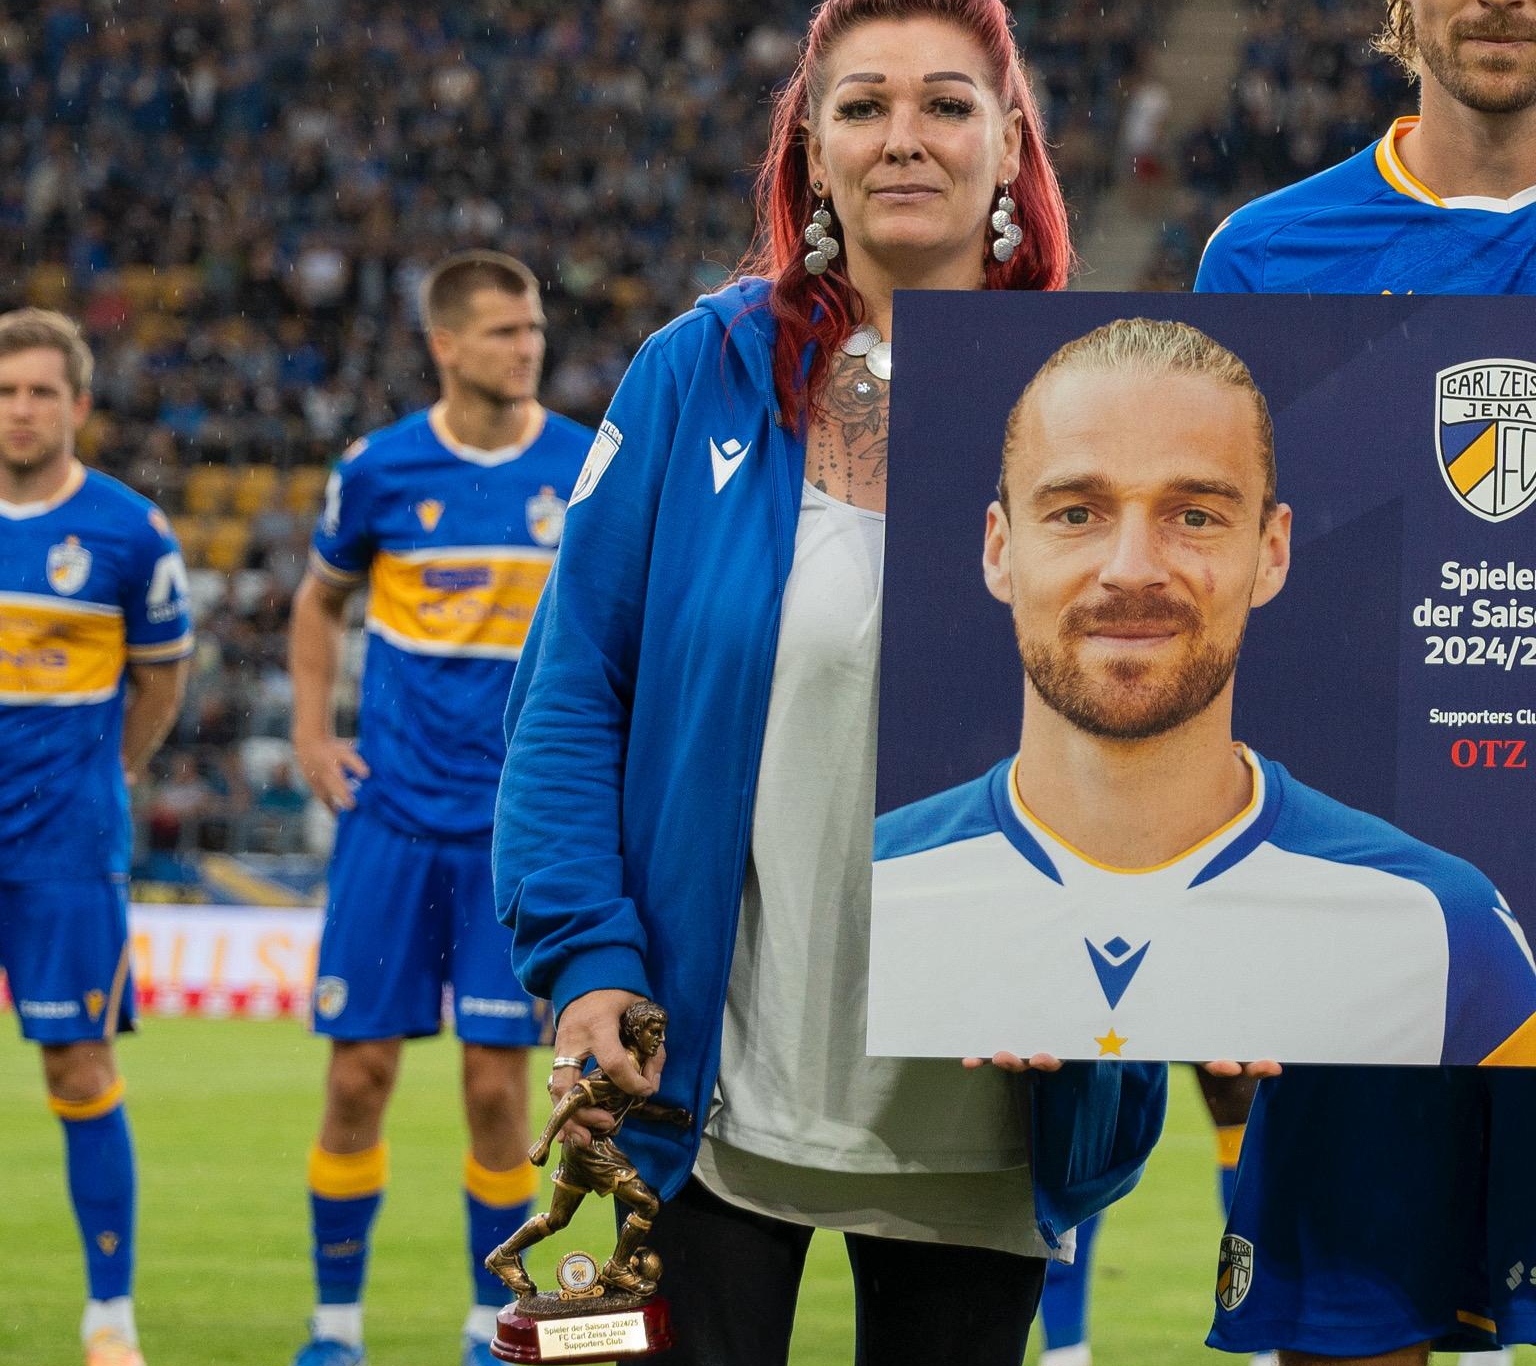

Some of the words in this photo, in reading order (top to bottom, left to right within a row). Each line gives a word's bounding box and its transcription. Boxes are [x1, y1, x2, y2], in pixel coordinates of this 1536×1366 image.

[1446, 370, 1497, 397] CARL
[1463, 403, 1532, 419] JENA
[1413, 598, 1464, 628] der
[1429, 709, 1513, 727] Supporters
[1450, 739, 1528, 769] OTZ
[544, 1325, 570, 1336] Spieler
[571, 1323, 583, 1332] der
[584, 1322, 610, 1331] Saison
[612, 1319, 639, 1329] 2024/25
[559, 1334, 569, 1342] FC
[571, 1332, 586, 1341] Carl
[587, 1331, 607, 1339] Zeiss
[609, 1329, 626, 1337] Jena
[564, 1339, 604, 1350] Supporters
[606, 1337, 623, 1346] Club
